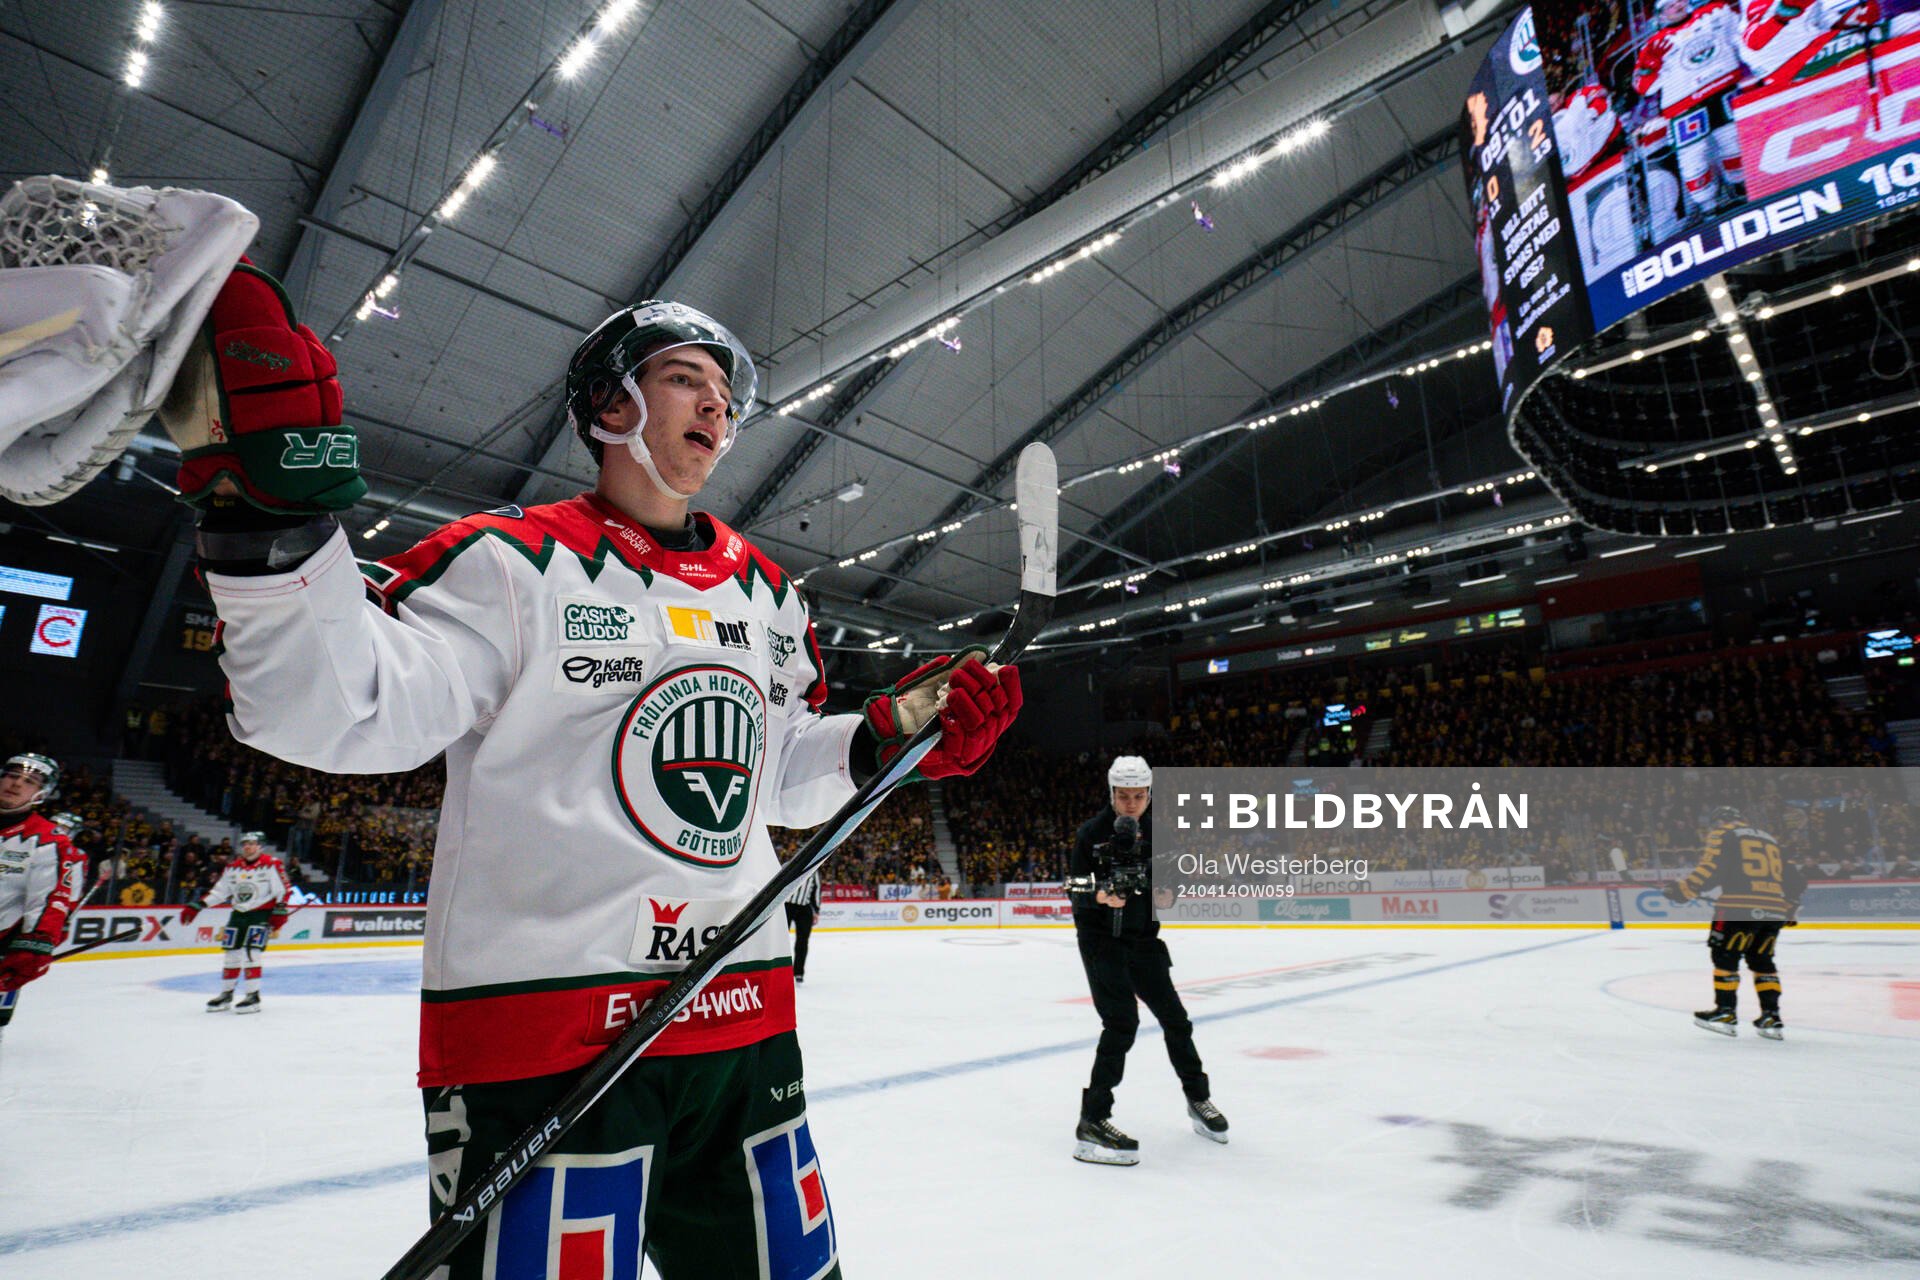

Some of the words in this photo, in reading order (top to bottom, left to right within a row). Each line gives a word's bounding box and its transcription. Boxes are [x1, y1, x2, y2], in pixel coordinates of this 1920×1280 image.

[1528, 118, 1547, 150] 2
[1633, 181, 1843, 293] BOLIDEN
[619, 531, 649, 556] SPORT
[679, 563, 708, 572] SHL
[566, 606, 612, 625] CASH
[567, 623, 628, 639] BUDDY
[603, 657, 643, 673] Kaffe
[592, 671, 642, 688] greven
[632, 676, 702, 740] FRÖLUNDA
[709, 675, 760, 711] HOCKEY
[676, 828, 742, 856] GÖTEBORG
[1300, 877, 1372, 894] Henson
[325, 891, 397, 904] LATITUDE
[924, 906, 993, 922] engcon
[72, 915, 174, 944] BDX
[353, 915, 423, 932] valutec
